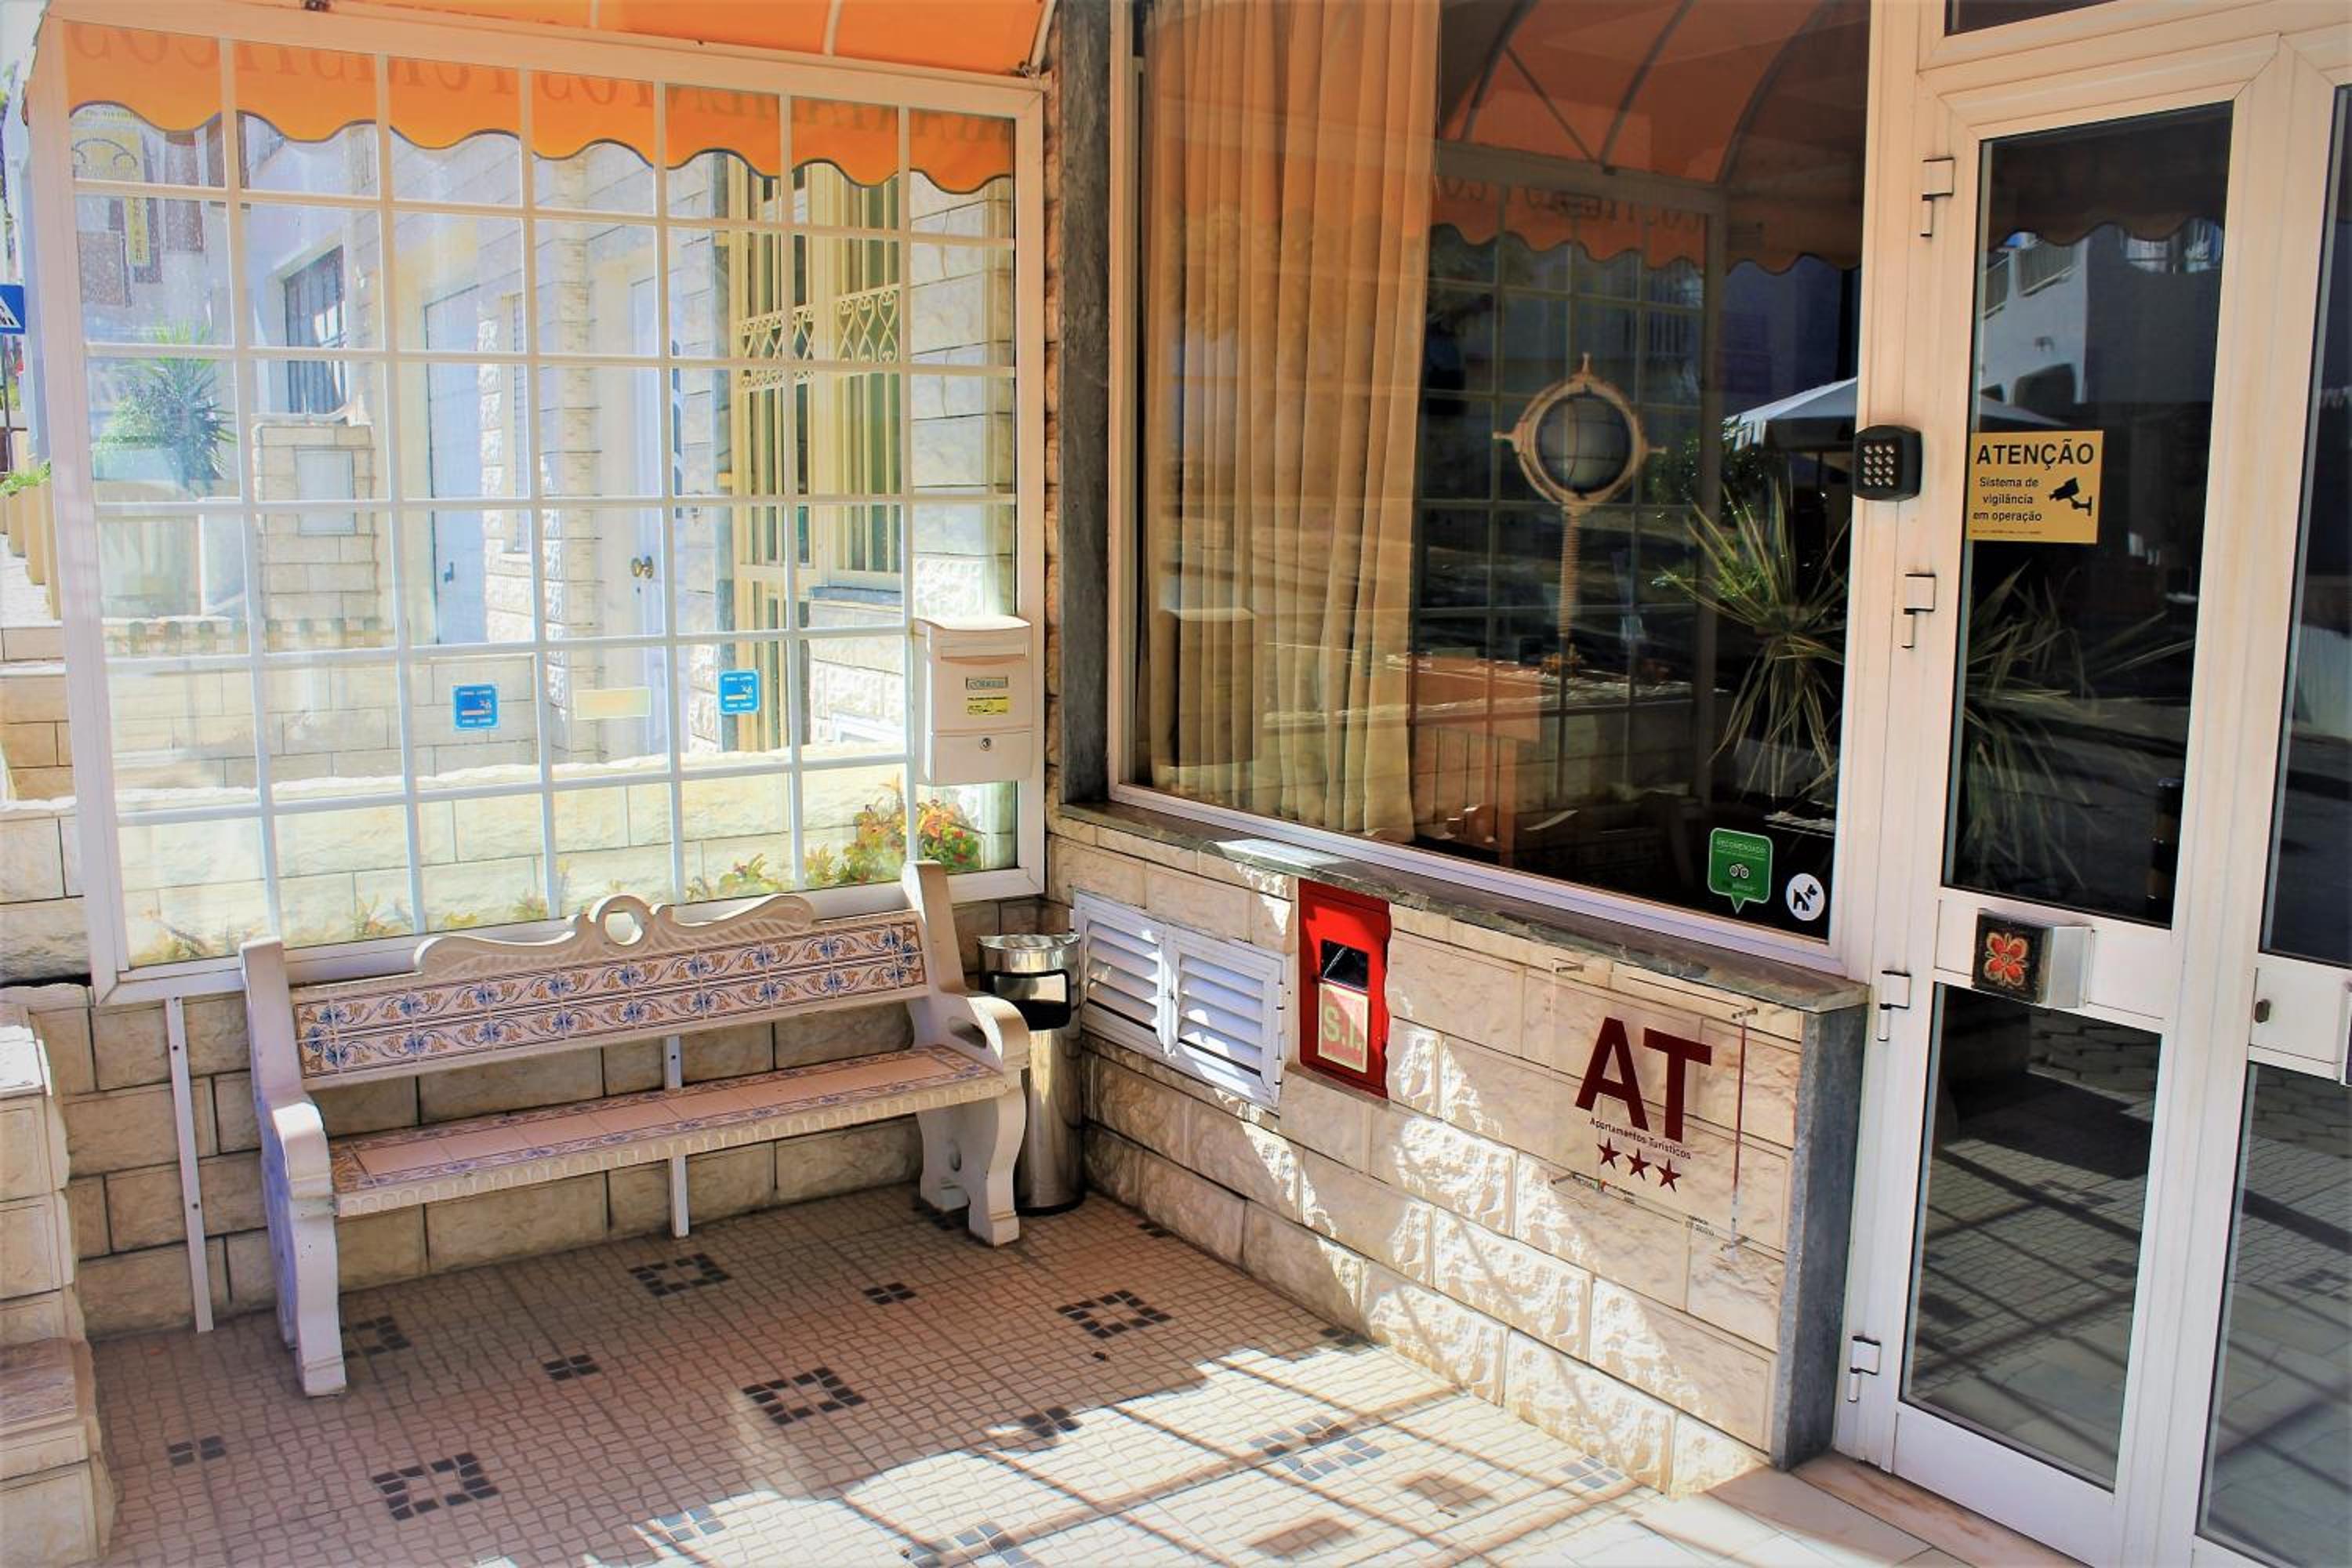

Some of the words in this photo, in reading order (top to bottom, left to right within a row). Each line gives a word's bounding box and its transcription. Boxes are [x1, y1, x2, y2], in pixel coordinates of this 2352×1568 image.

[1976, 438, 2094, 470] ATENÇÃO
[1980, 477, 2022, 488] Sistema
[2025, 477, 2038, 488] de
[1983, 493, 2033, 506] vigilância
[1973, 511, 1989, 520] em
[1992, 511, 2042, 522] operação
[1575, 1017, 1712, 1143] AT
[1590, 1117, 1646, 1145] Apartamentos
